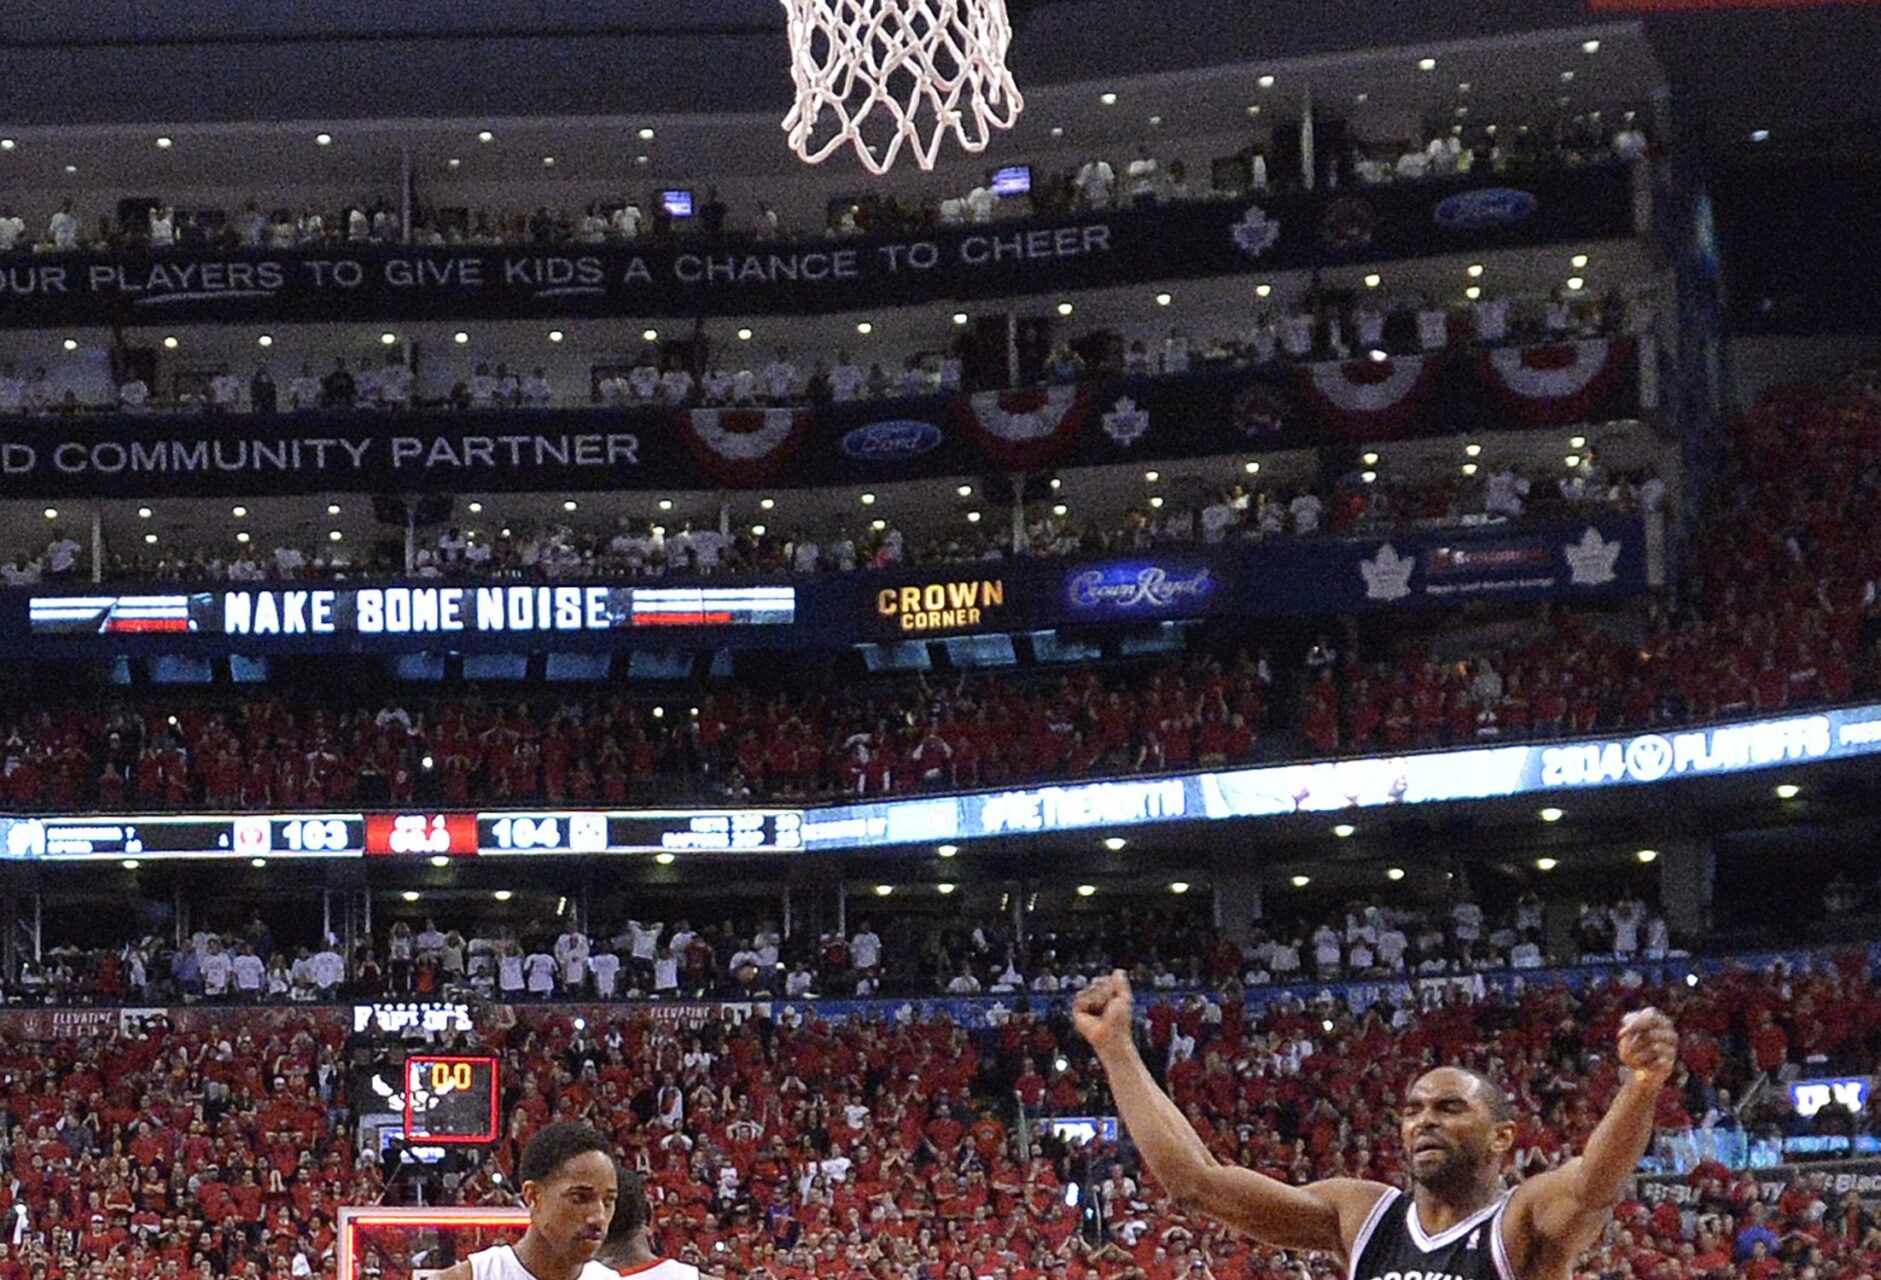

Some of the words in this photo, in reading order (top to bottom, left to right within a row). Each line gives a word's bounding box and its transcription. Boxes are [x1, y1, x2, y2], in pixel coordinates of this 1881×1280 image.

[0, 265, 68, 294] UR
[90, 261, 284, 291] PLAYERS
[306, 260, 363, 287] TO
[384, 258, 483, 286] GIVE
[505, 256, 603, 284] KIDS
[624, 256, 652, 284] A
[673, 247, 858, 283] CHANCE
[879, 242, 939, 274] TO
[960, 225, 1111, 265] CHEER
[52, 437, 371, 474] COMMUNITY
[392, 432, 639, 469] PARTNER
[224, 589, 335, 633] MAKE
[357, 588, 464, 631] SOME
[477, 586, 611, 631] NOISE
[877, 580, 1004, 616] CROWN
[901, 608, 981, 631] CORNER
[282, 818, 348, 851] 103
[492, 816, 561, 849] 104
